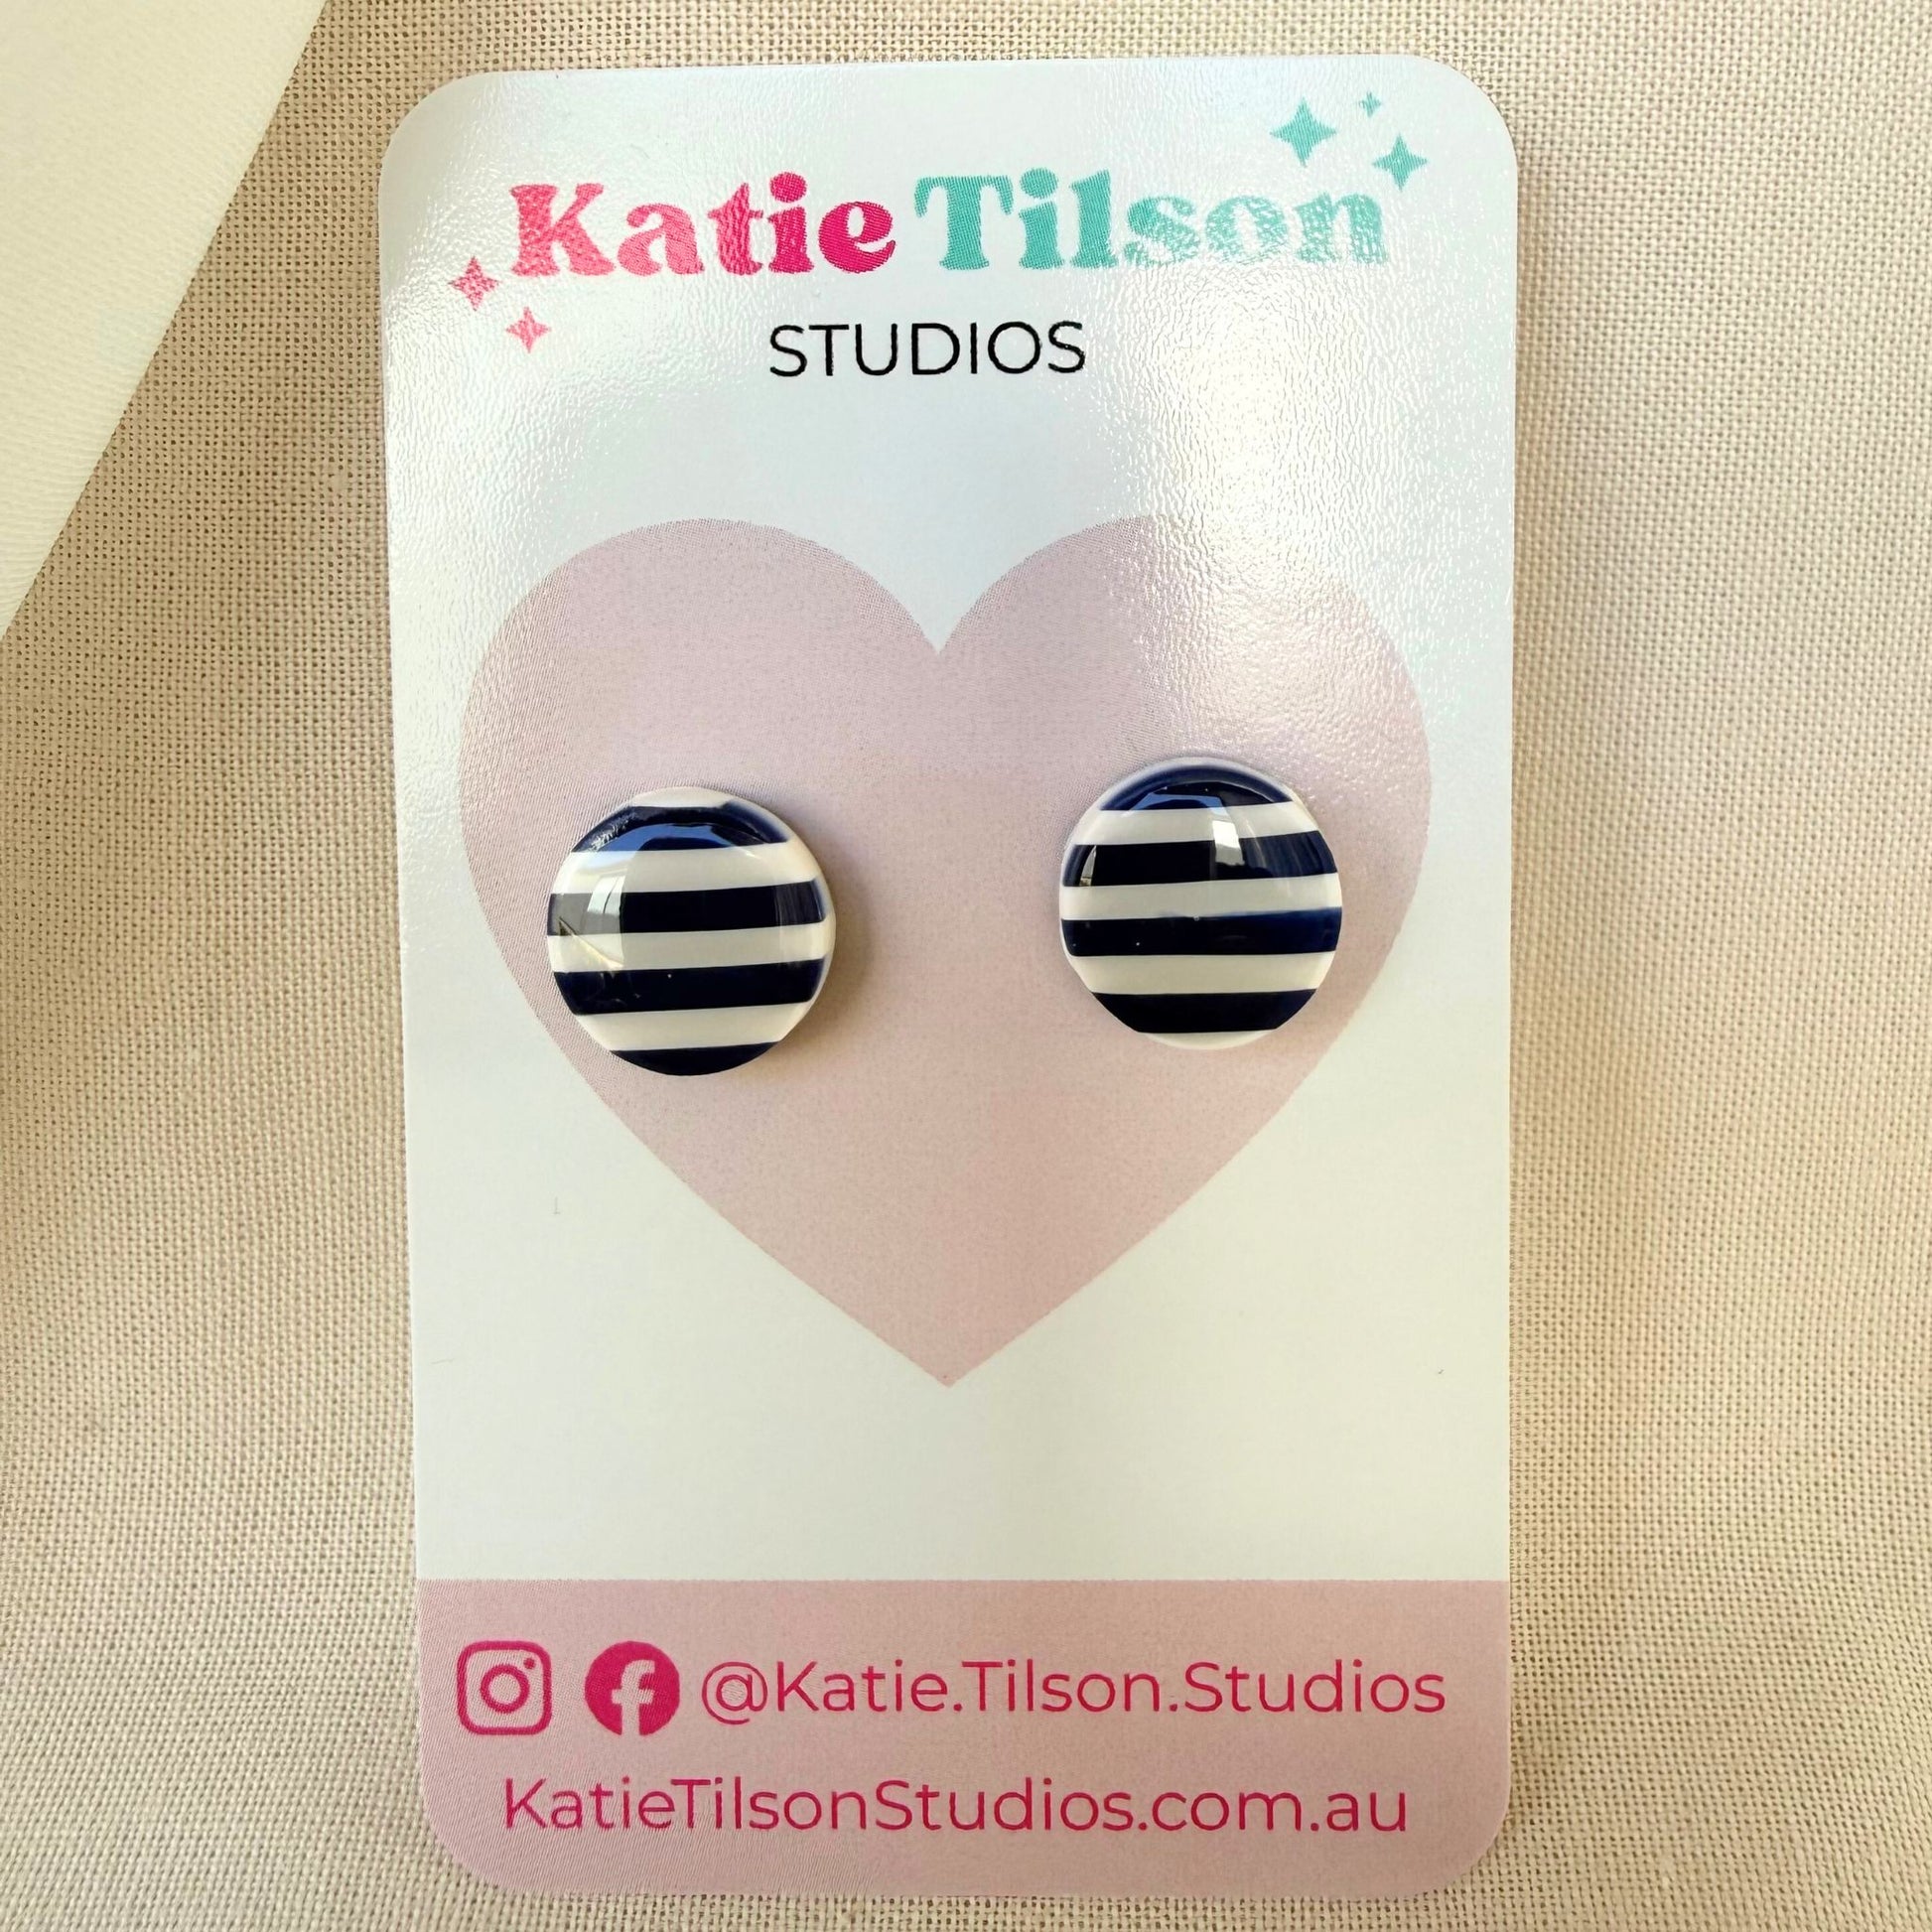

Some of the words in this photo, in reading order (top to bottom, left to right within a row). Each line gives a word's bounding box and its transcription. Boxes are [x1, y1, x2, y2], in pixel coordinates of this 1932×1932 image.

[510, 171, 897, 276] Katie
[913, 168, 1386, 272] Tilson
[768, 320, 1086, 377] STUDIOS
[700, 1658, 1446, 1725] @Katie.Tilson.Studios
[504, 1776, 1408, 1833] KatieTilsonStudios.com.au
